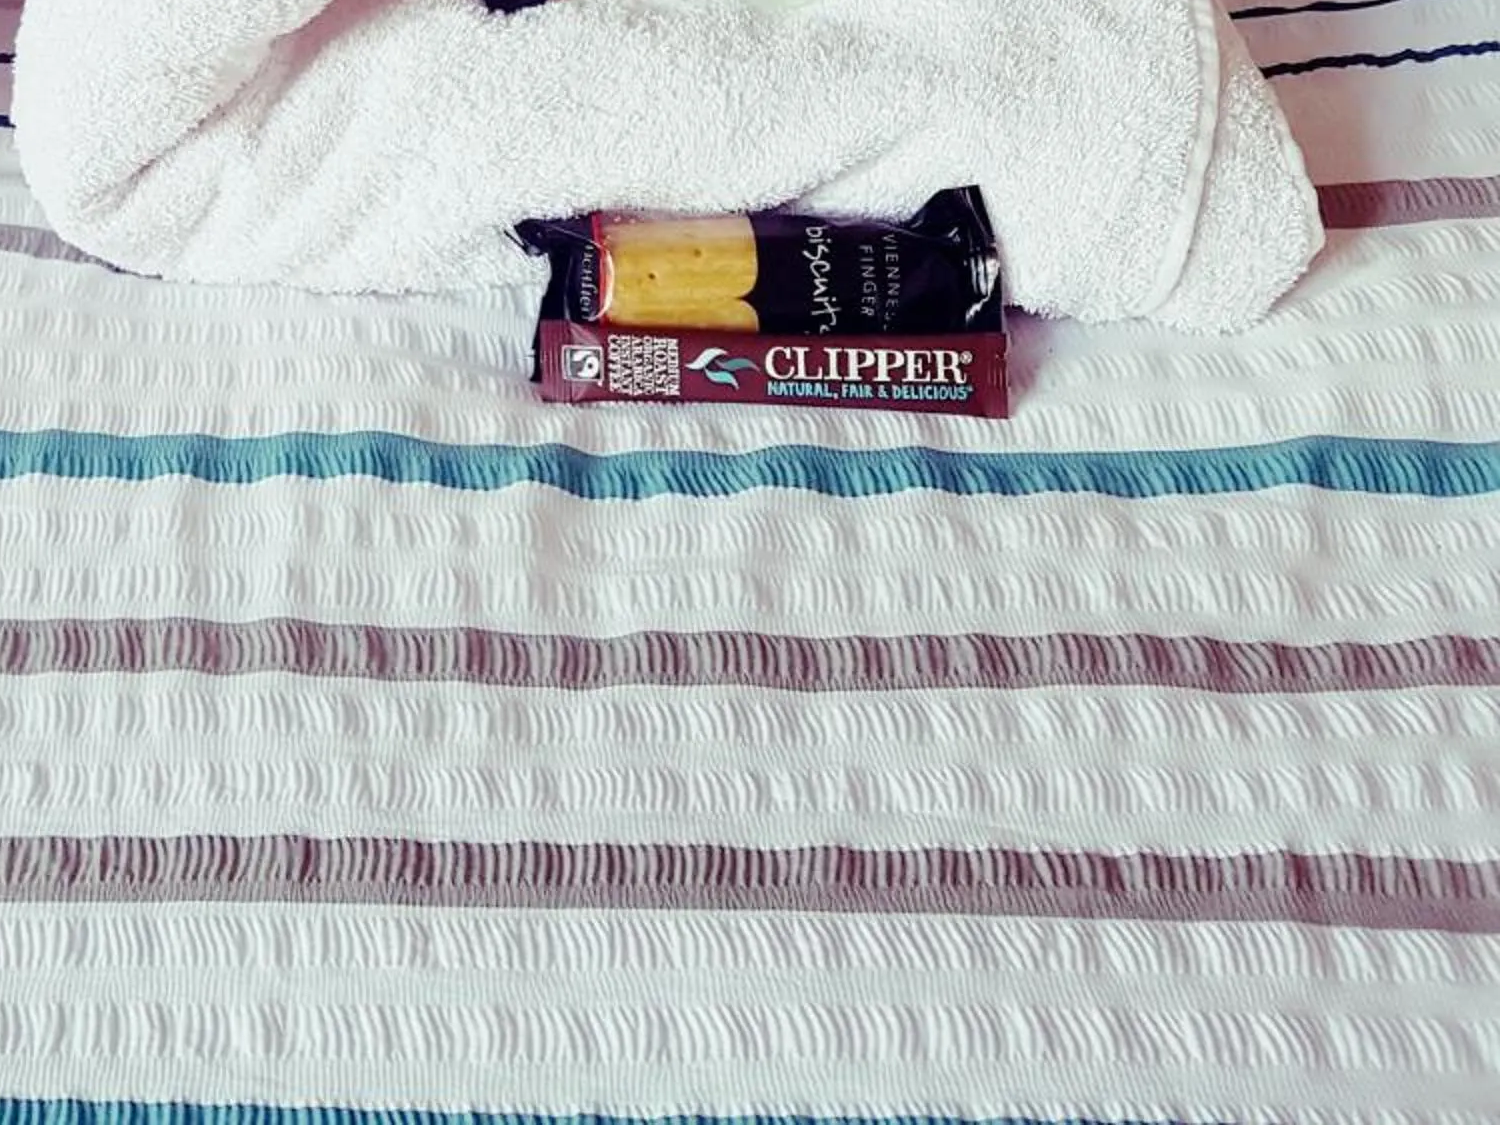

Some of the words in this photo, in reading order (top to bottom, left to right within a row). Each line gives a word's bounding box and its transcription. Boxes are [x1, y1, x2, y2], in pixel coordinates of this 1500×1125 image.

[860, 244, 877, 316] FINGER
[608, 334, 621, 391] COFFEE
[619, 335, 633, 395] INSTANT
[631, 335, 644, 396] ARABICA
[643, 335, 654, 395] ORGANIC
[653, 336, 668, 394] ROAST
[767, 381, 839, 400] NATURAL,
[841, 383, 874, 399] FAIR
[878, 385, 889, 399] &
[892, 384, 968, 400] DELICIOUS
